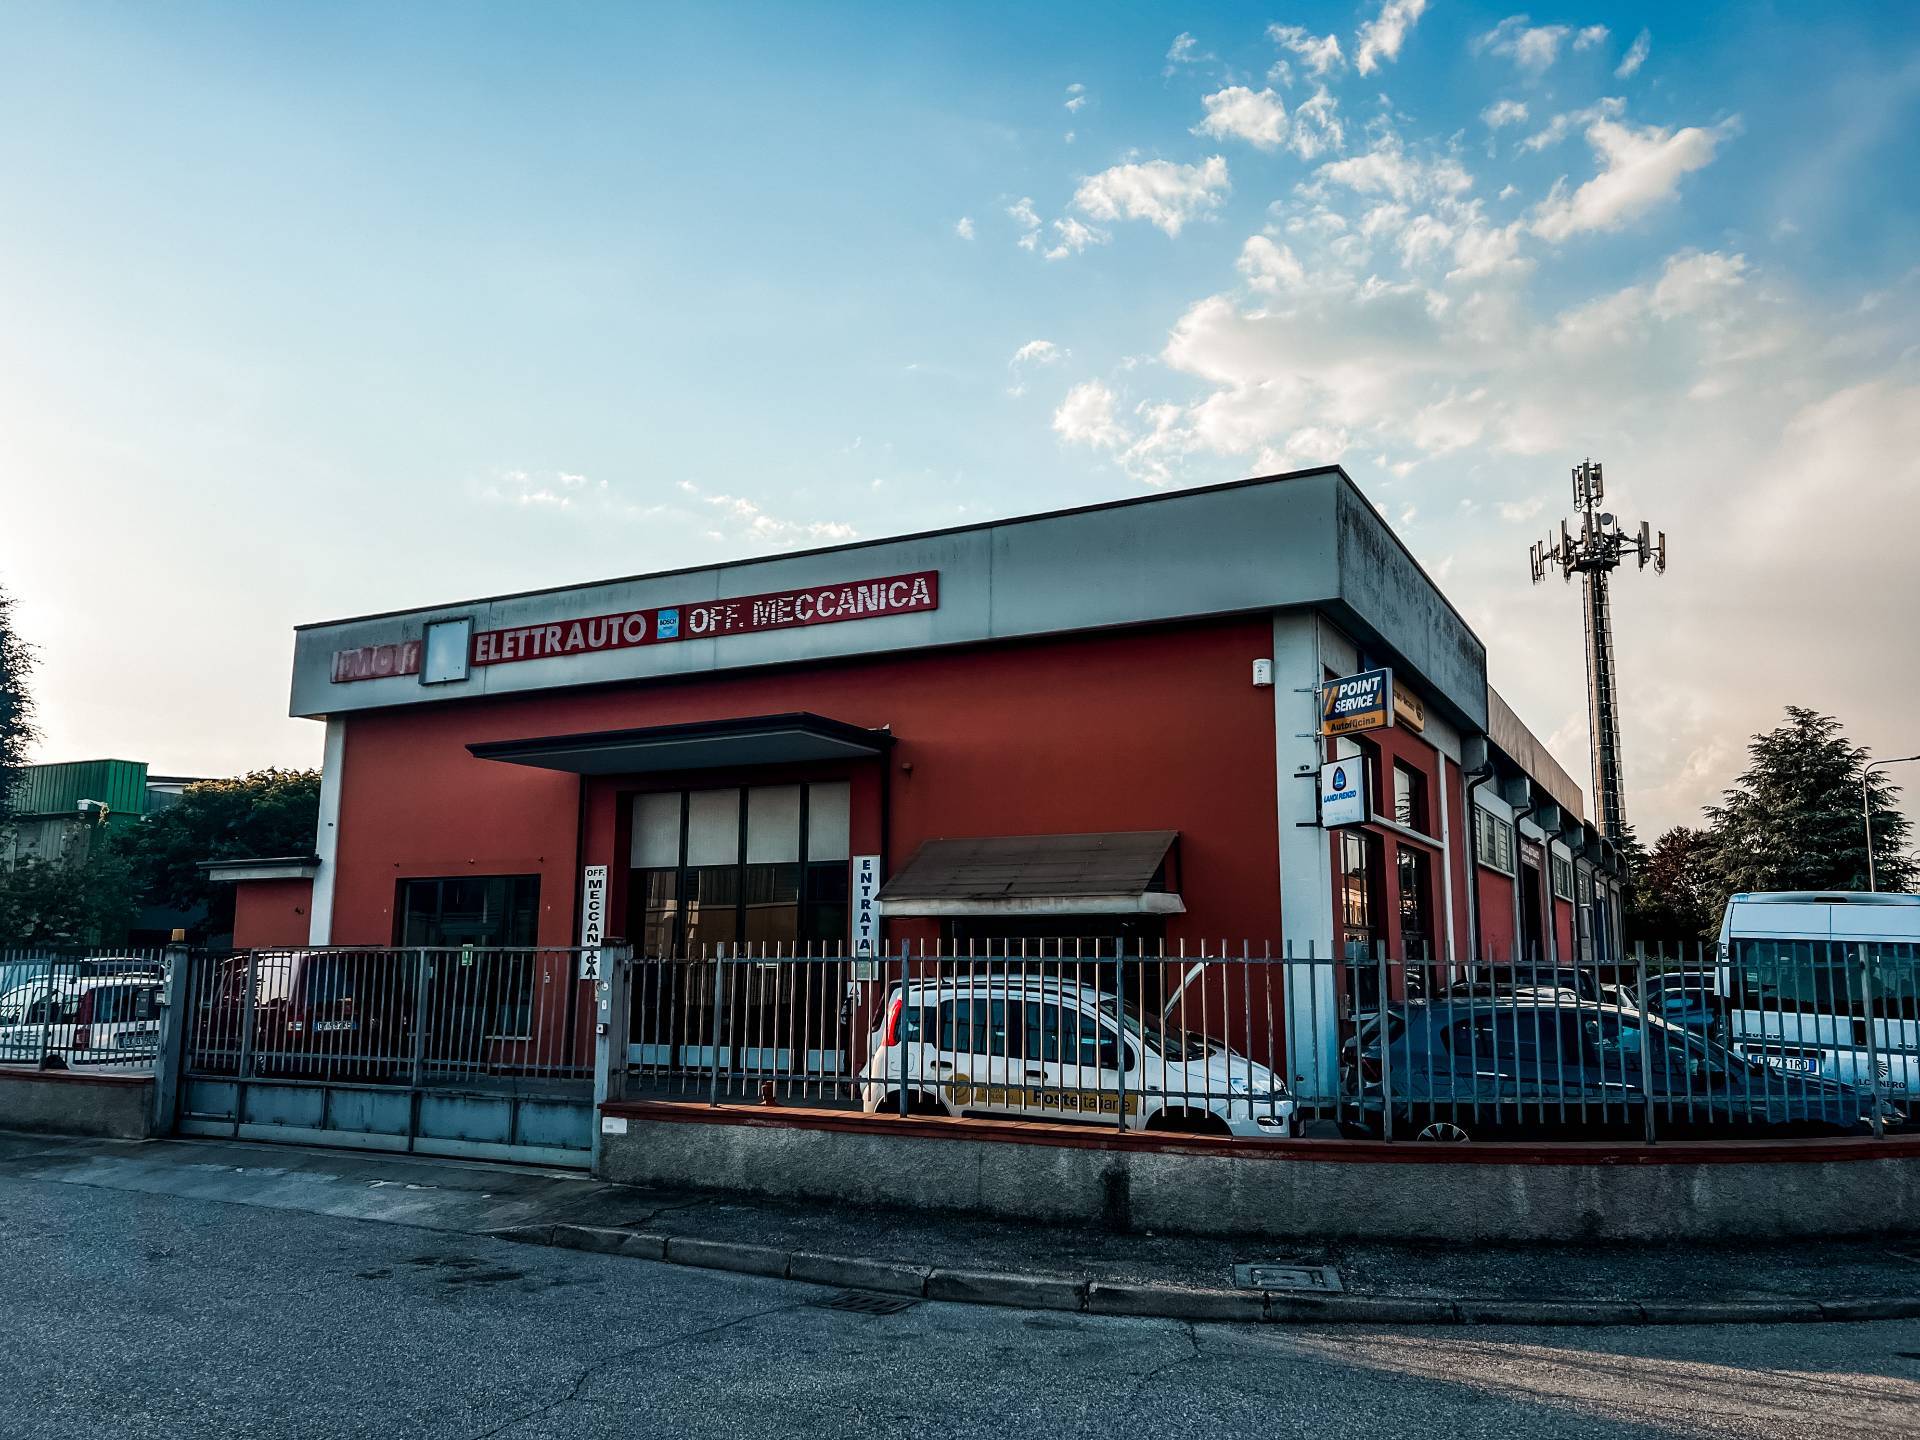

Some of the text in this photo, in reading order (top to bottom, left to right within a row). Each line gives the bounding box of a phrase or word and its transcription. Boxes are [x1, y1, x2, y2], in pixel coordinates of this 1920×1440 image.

[689, 577, 931, 633] OFF. MECCANICA
[660, 618, 677, 626] BOSCH
[475, 613, 647, 662] ELETTRAUTO
[1338, 676, 1381, 699] POINT
[1334, 693, 1374, 714] SERVICE
[586, 869, 605, 877] OFF.
[859, 859, 872, 950] ENTRATA
